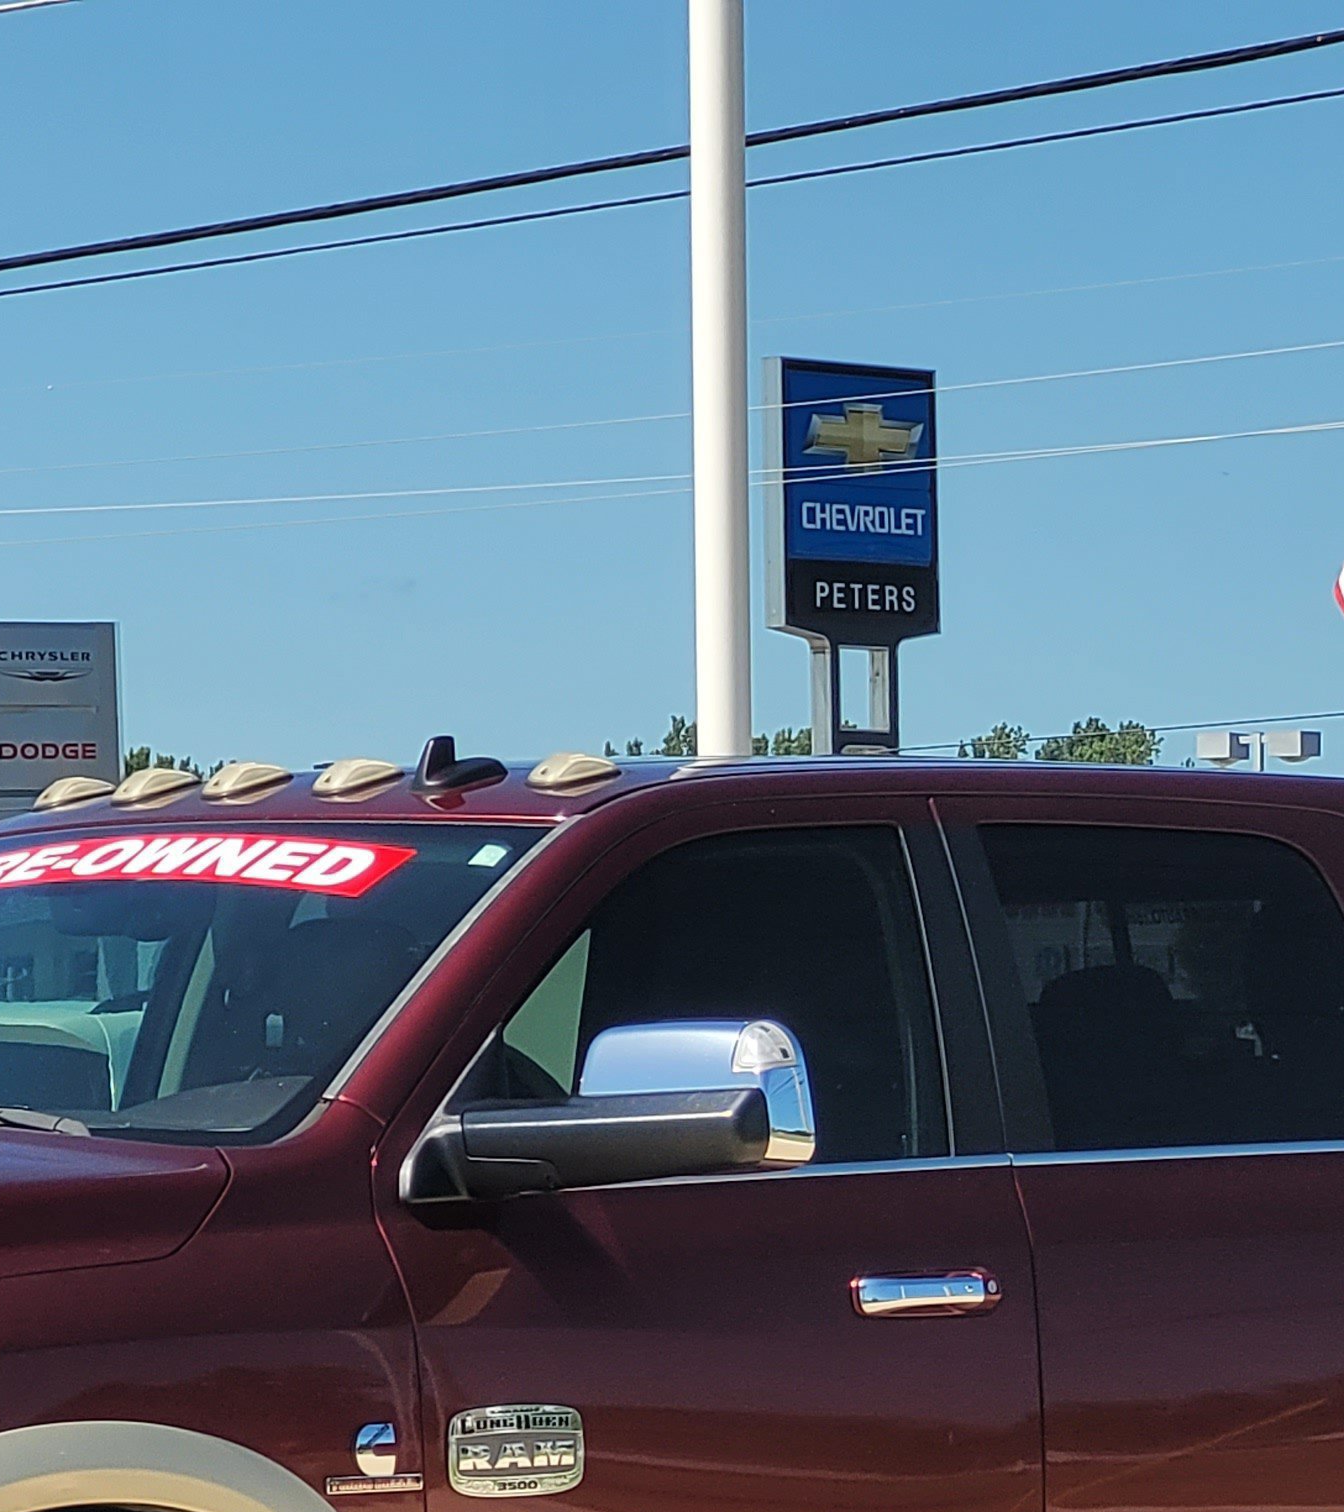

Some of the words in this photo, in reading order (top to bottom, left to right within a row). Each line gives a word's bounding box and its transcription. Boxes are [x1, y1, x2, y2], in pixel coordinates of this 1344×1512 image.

[801, 501, 926, 537] CHEVROLET
[815, 580, 916, 613] PETERS
[459, 1440, 575, 1471] RAM
[497, 1480, 538, 1492] 3500
